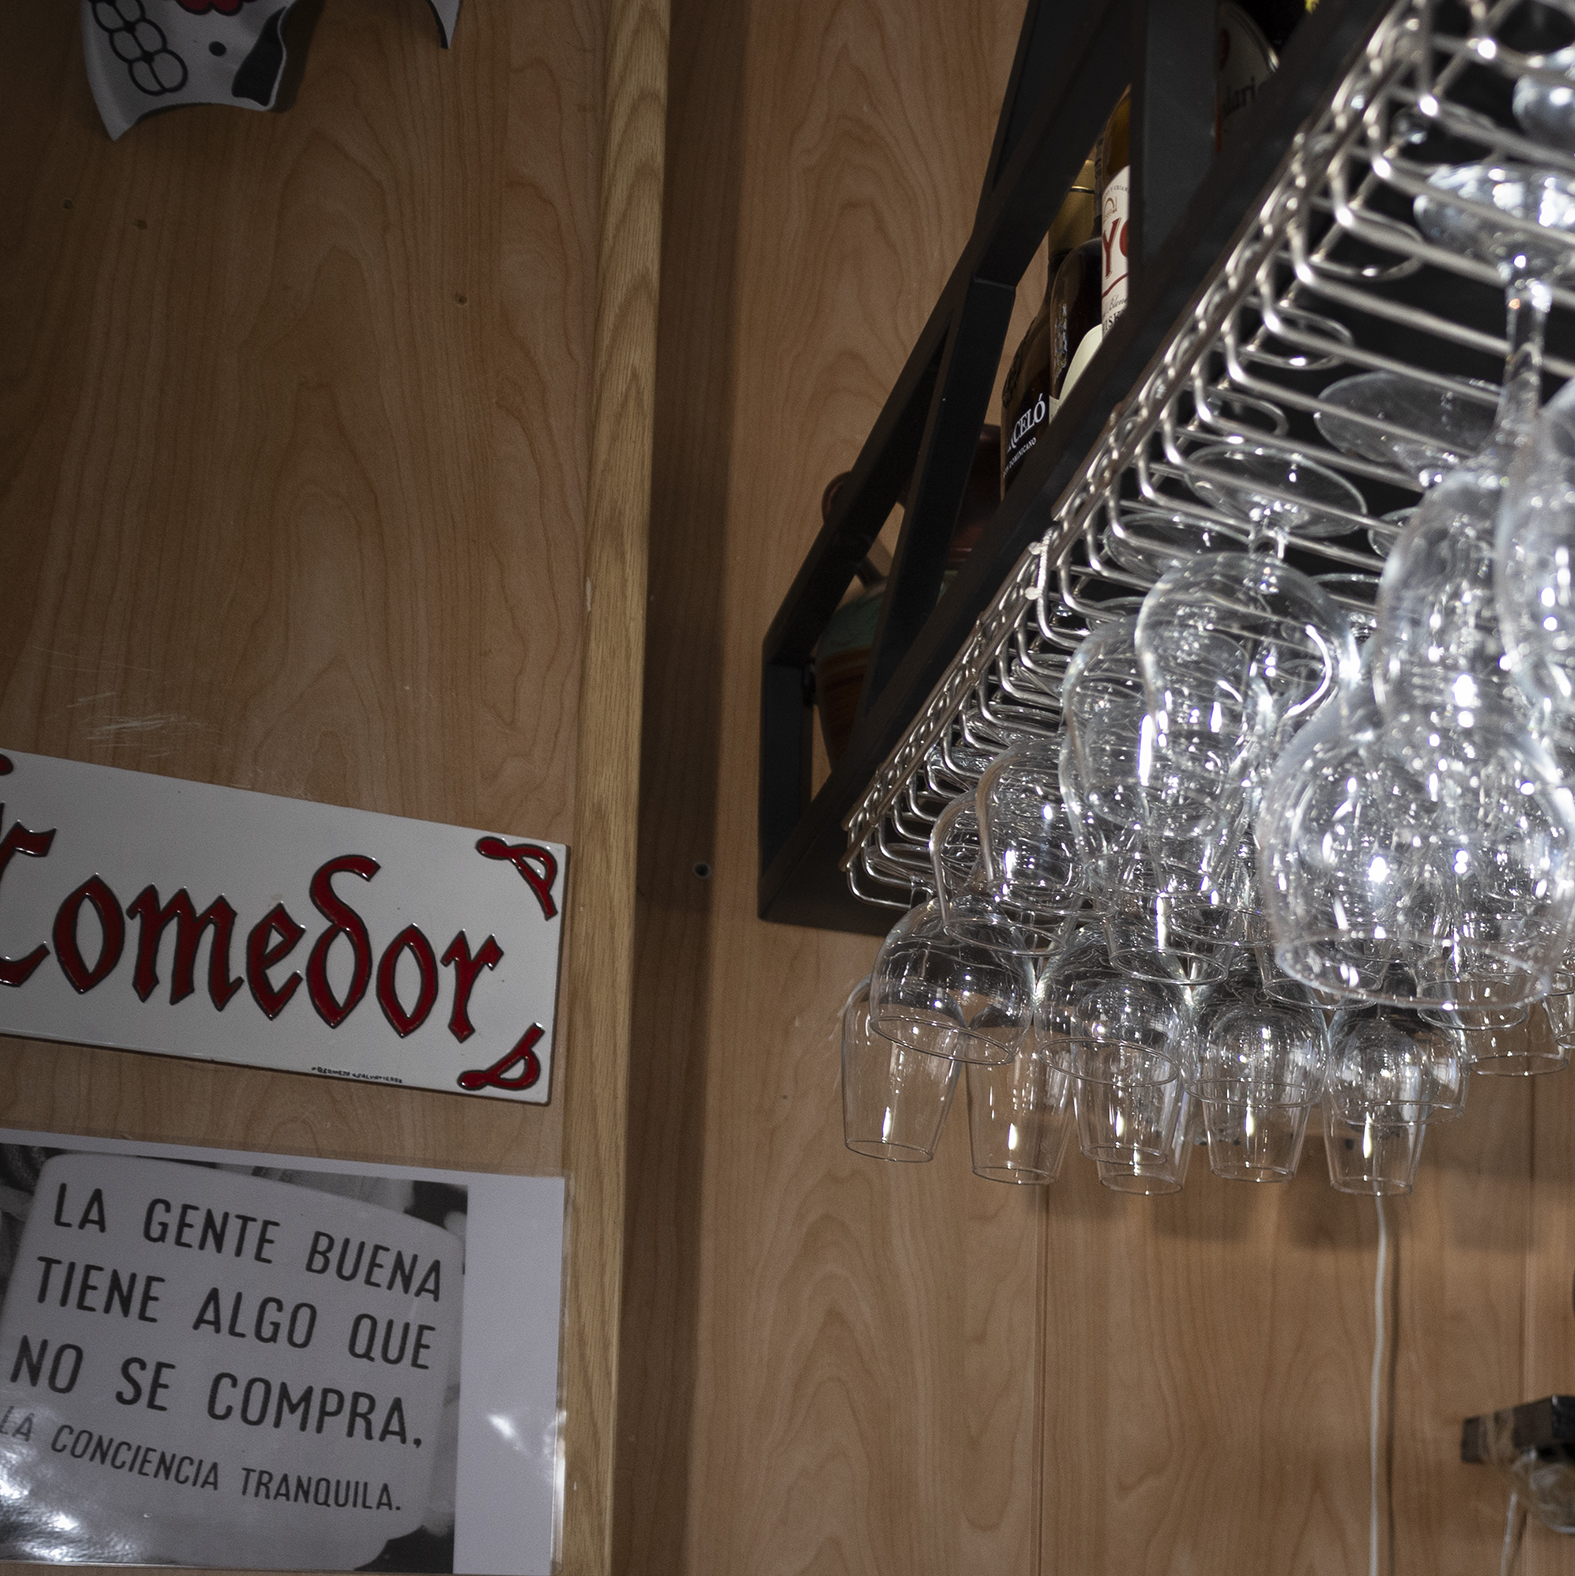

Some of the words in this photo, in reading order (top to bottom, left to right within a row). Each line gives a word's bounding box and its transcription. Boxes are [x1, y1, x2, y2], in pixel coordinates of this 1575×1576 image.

[53, 1182, 108, 1234] LA
[142, 1198, 281, 1266] GENTE
[305, 1230, 444, 1303] BUENA
[36, 1254, 167, 1325] TIENE
[192, 1285, 318, 1351] ALGO
[347, 1312, 436, 1371] QUE
[9, 1334, 85, 1397] NO
[115, 1356, 177, 1413] SE
[206, 1370, 424, 1450] COMPRA.
[0, 1405, 35, 1443] LA
[50, 1424, 220, 1492] CONCIENCIA
[240, 1466, 402, 1512] TRANQUILA.
